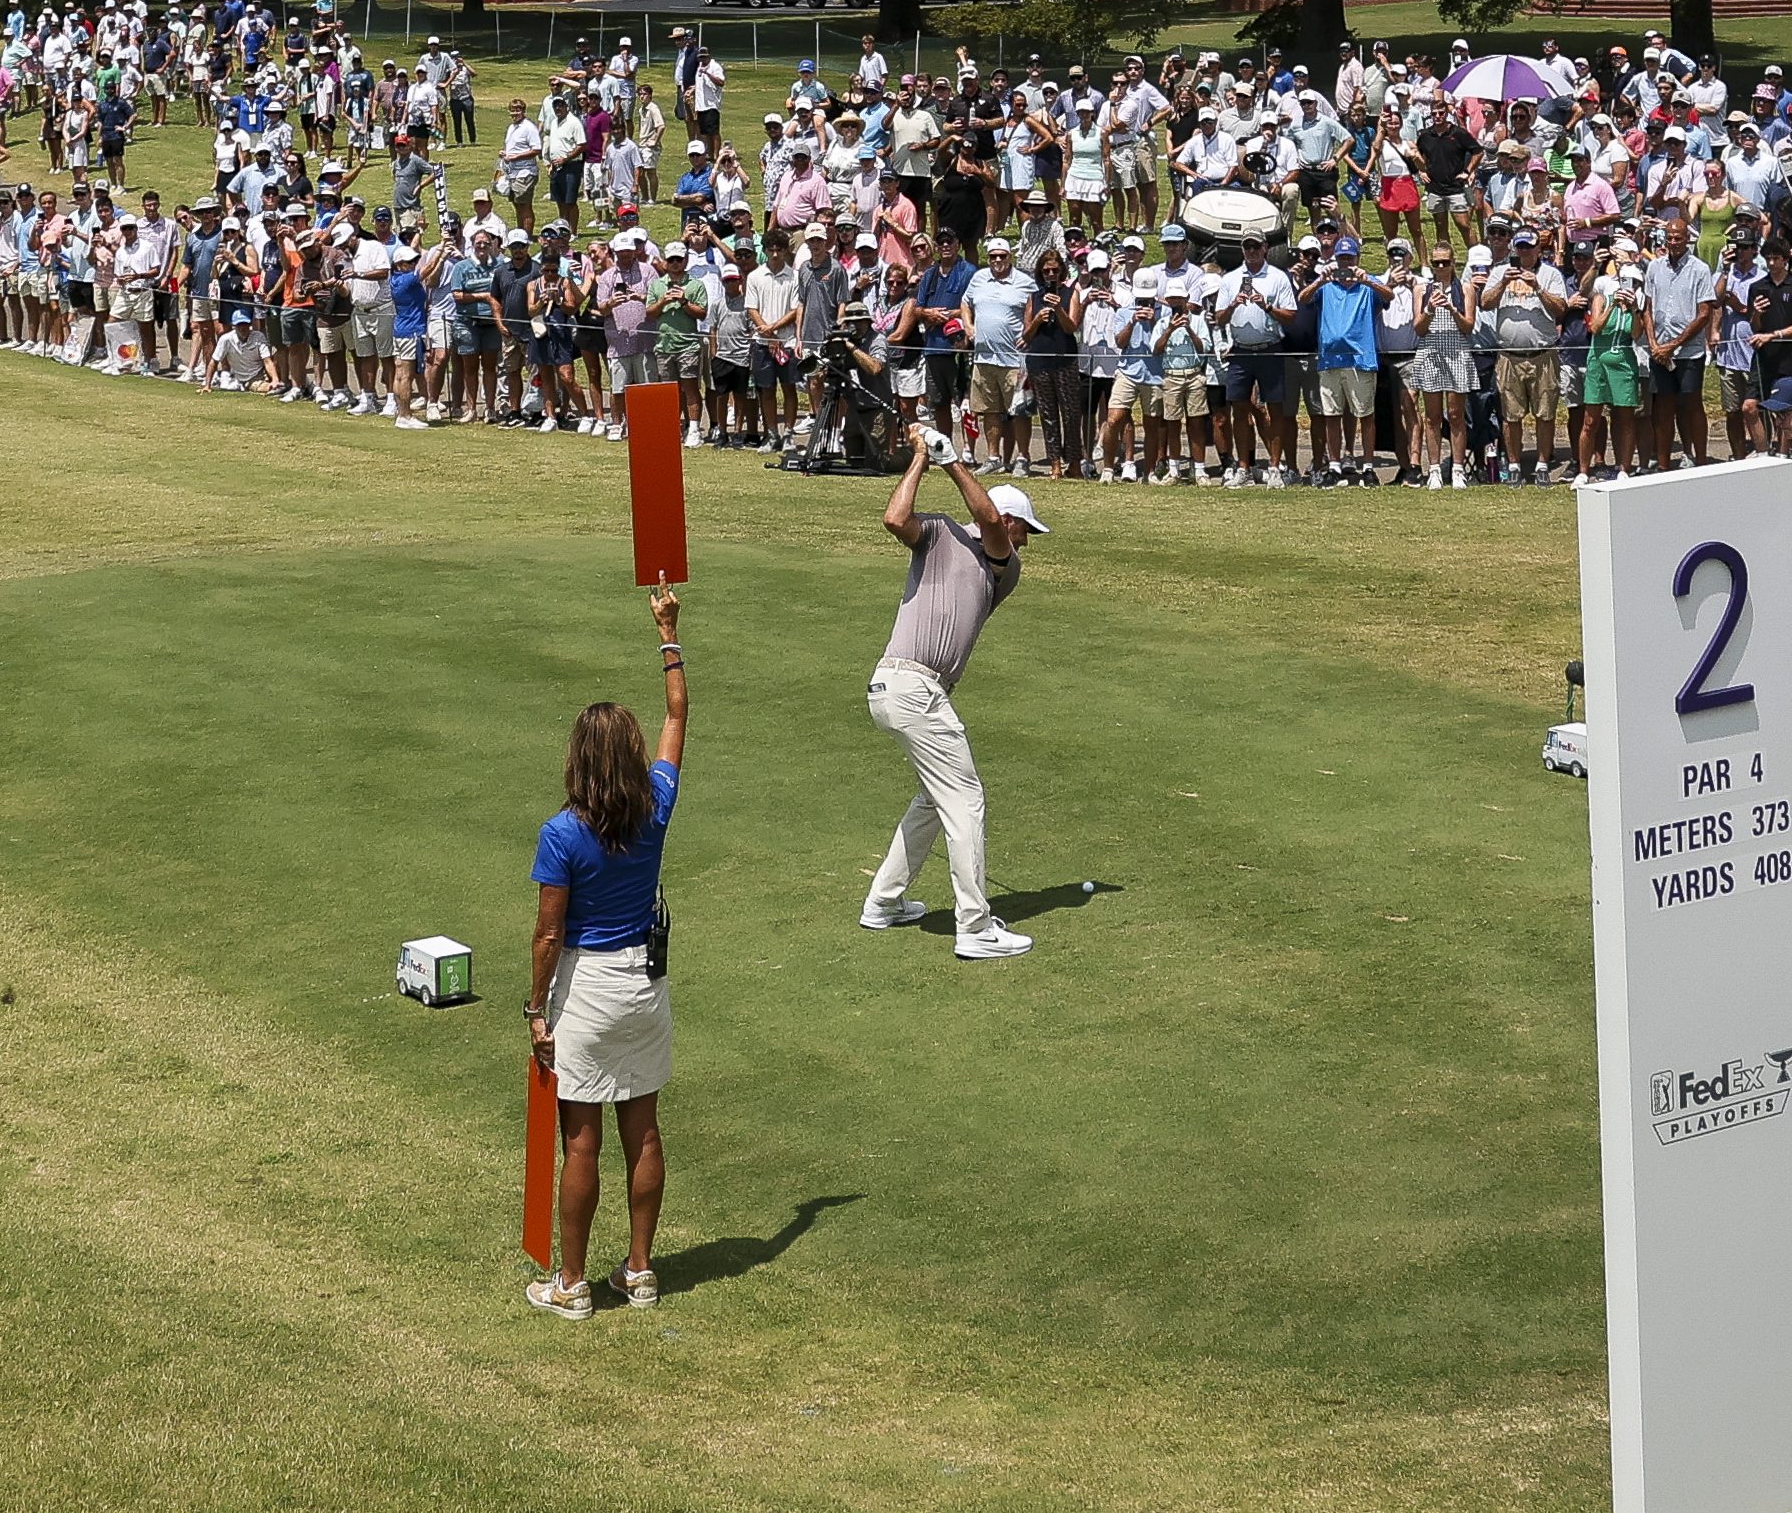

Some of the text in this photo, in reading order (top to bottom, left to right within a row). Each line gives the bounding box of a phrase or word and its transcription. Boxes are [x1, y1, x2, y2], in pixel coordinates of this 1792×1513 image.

[434, 176, 449, 225] HUSH
[1673, 541, 1755, 713] 2
[1683, 753, 1764, 797] PAR 4
[1634, 800, 1791, 862] METERS 373
[1652, 851, 1792, 909] YARDS 408
[1678, 1059, 1765, 1109] FedEx
[1670, 1098, 1774, 1138] PLAYOFFS
